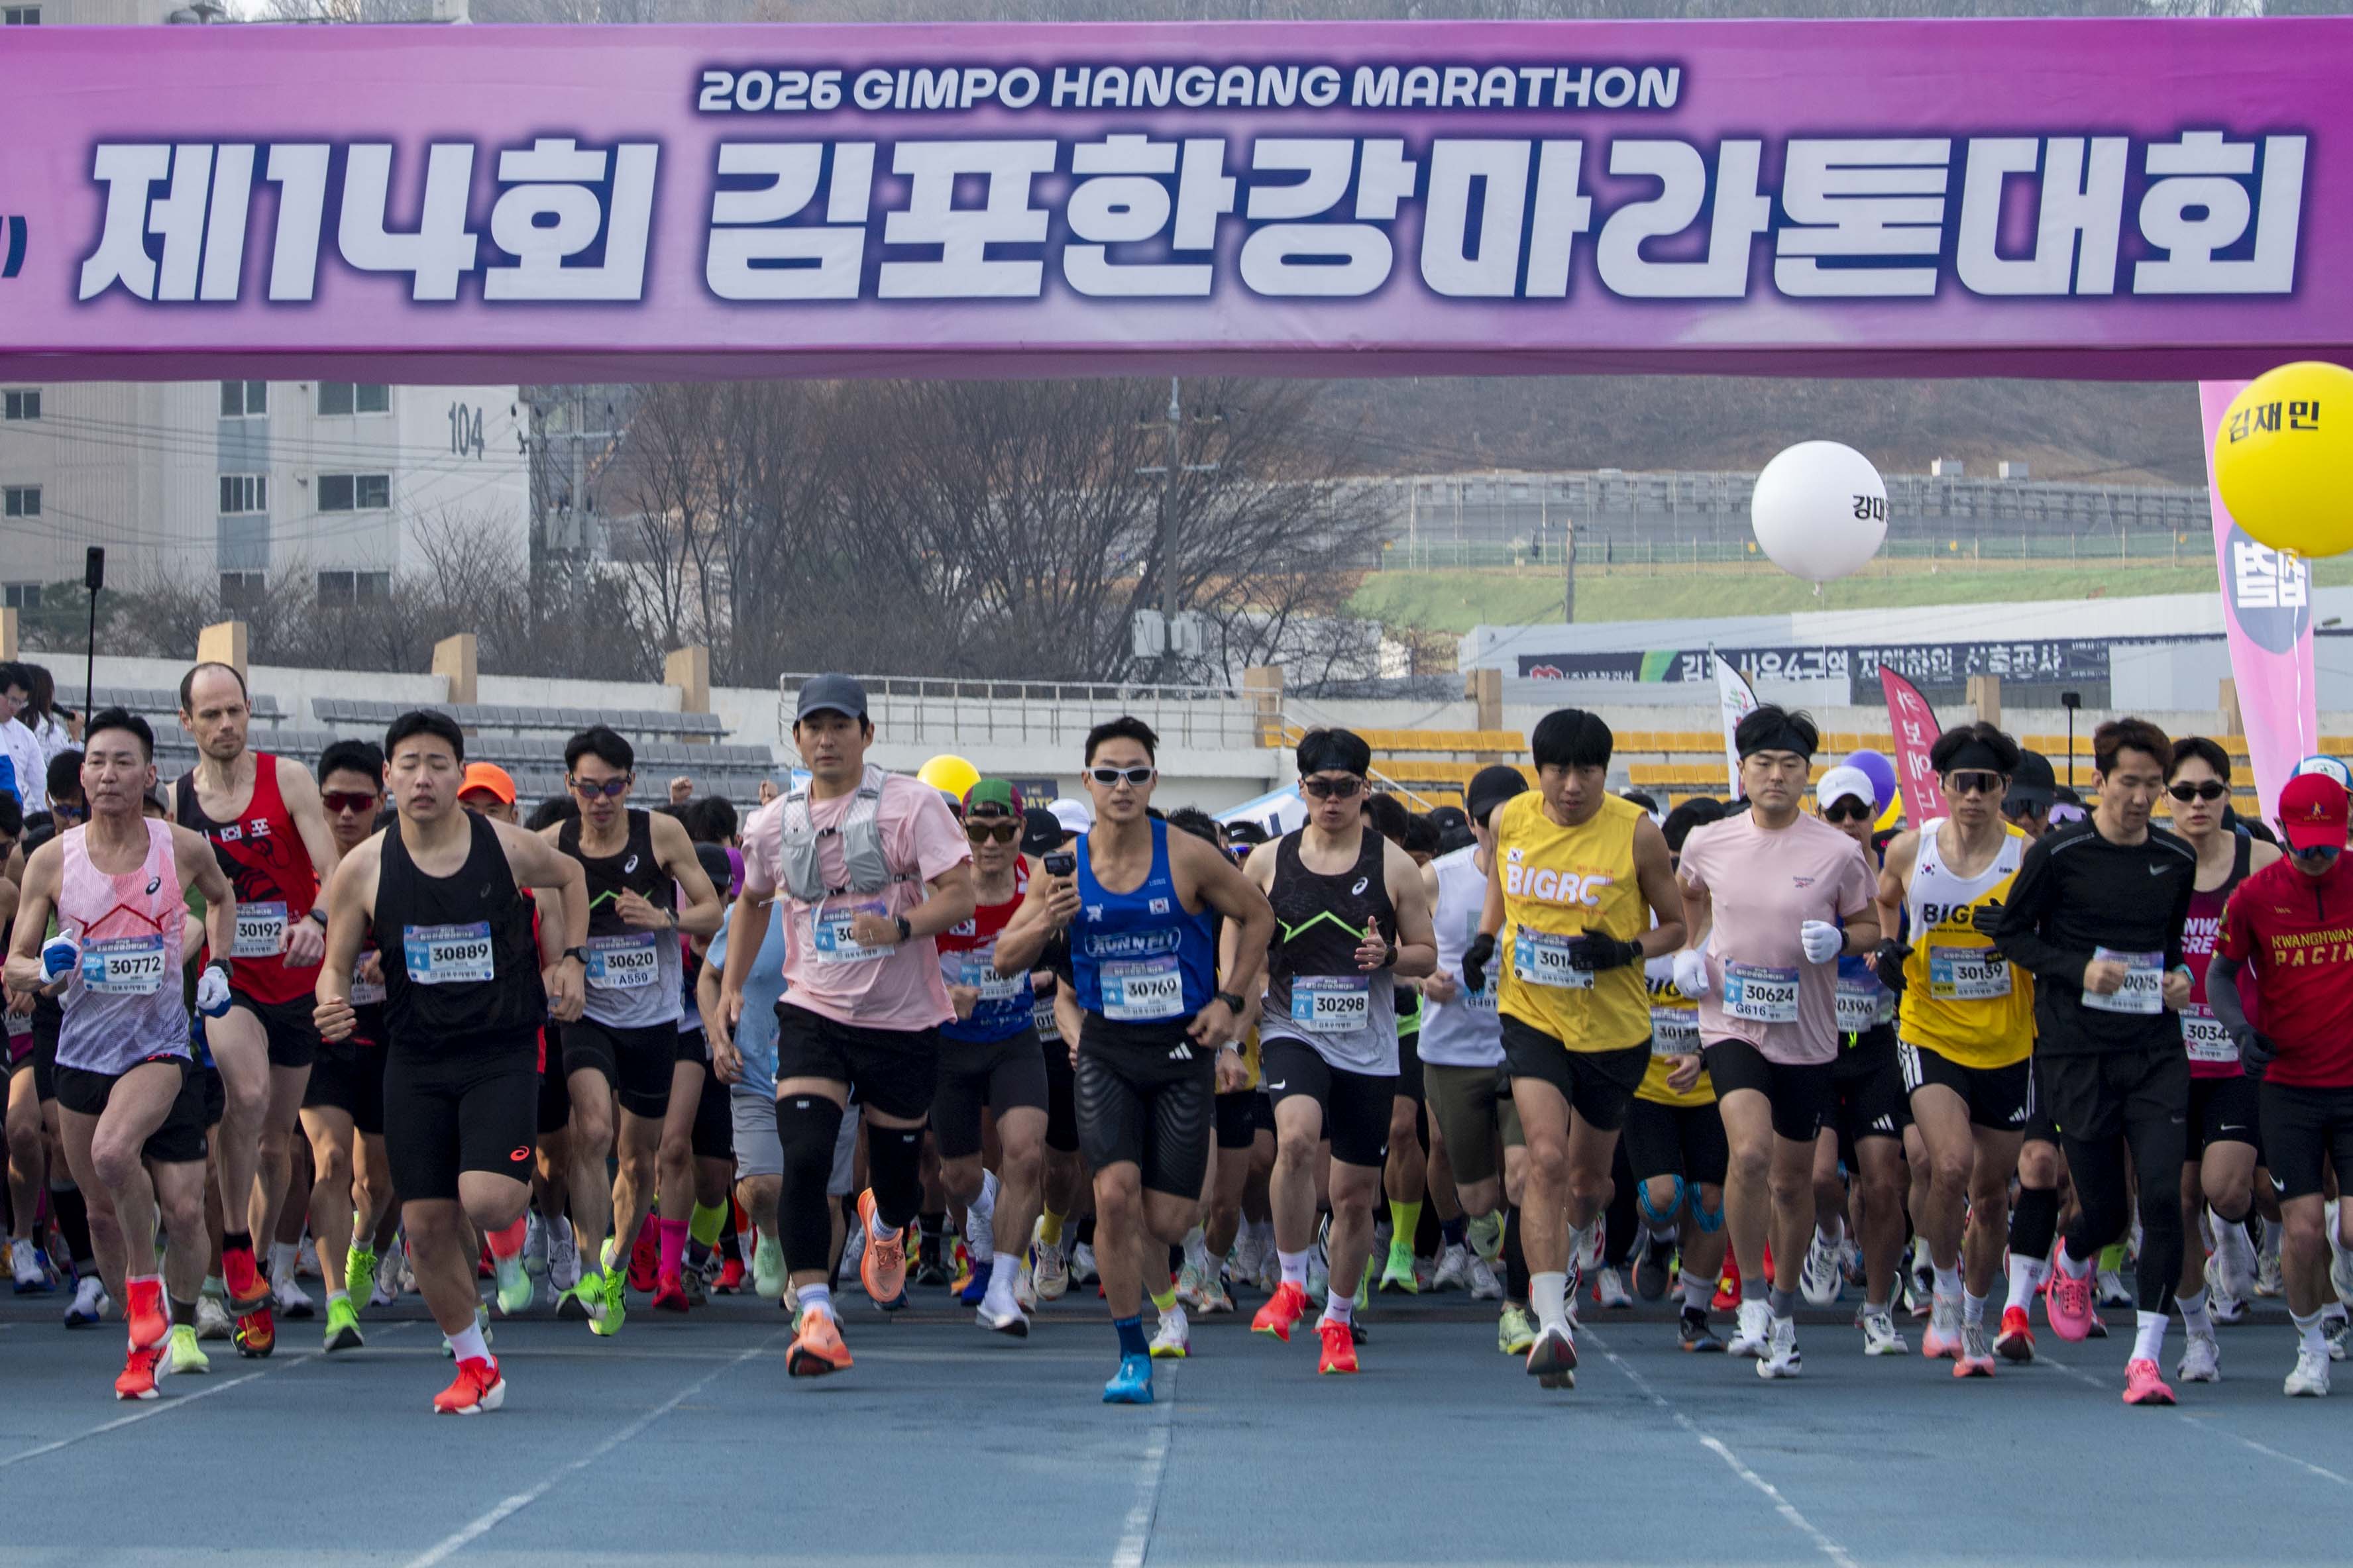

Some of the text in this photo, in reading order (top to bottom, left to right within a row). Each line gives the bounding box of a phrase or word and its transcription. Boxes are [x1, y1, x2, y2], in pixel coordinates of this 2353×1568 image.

[698, 67, 1680, 111] 2026 GIMPO HANGANG MARATHON
[78, 131, 2307, 302] 제14회 김포한강마라톤대회
[448, 399, 484, 460] 104
[2230, 401, 2320, 444] 김재민
[1852, 494, 1889, 523] 강대
[251, 817, 272, 837] 포
[239, 921, 282, 937] 30192
[433, 943, 488, 962] 30889
[608, 952, 654, 968] 30620
[110, 956, 161, 974] 30772
[1957, 961, 2003, 979] 30139
[1127, 977, 1177, 998] 30769
[1746, 984, 1794, 1002] 30624
[1317, 997, 1365, 1012] 30298
[1736, 1003, 1766, 1016] G616
[1836, 998, 1873, 1016] 0396
